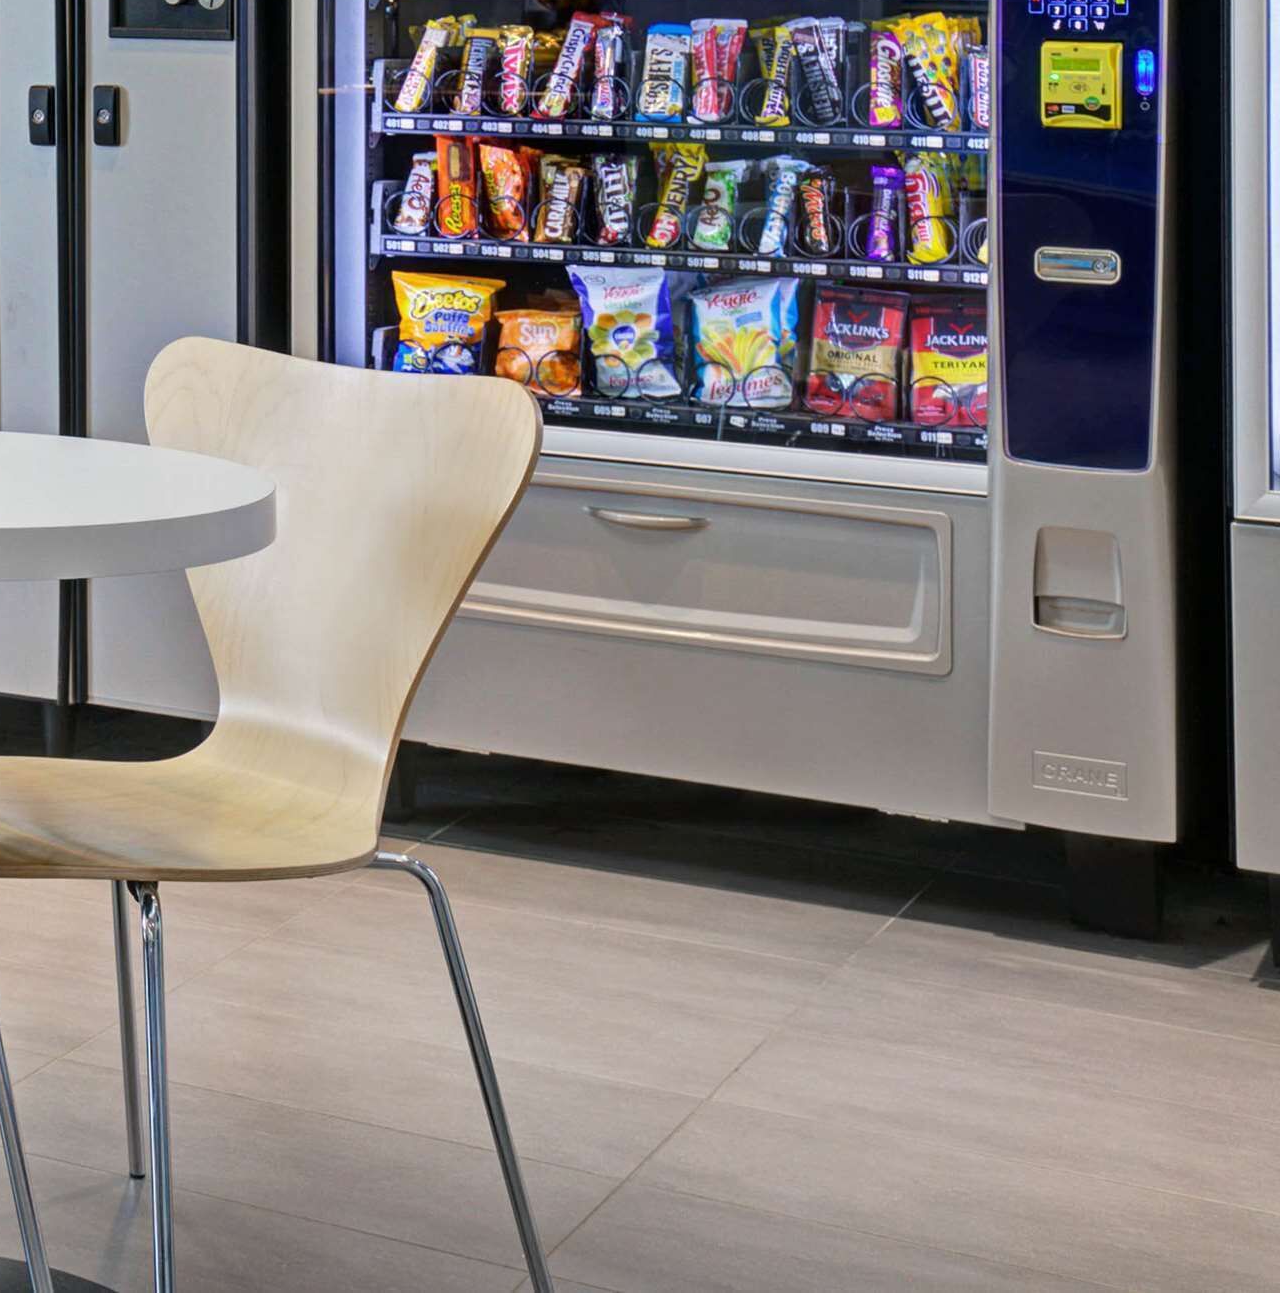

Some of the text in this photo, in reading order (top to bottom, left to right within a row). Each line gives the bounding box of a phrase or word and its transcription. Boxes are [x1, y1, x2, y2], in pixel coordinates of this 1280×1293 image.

[434, 311, 470, 324] Puffs
[852, 325, 890, 339] LINK'S
[925, 333, 959, 348] JACK
[933, 360, 986, 369] TERIYAK
[1043, 764, 1118, 788] CRANE
